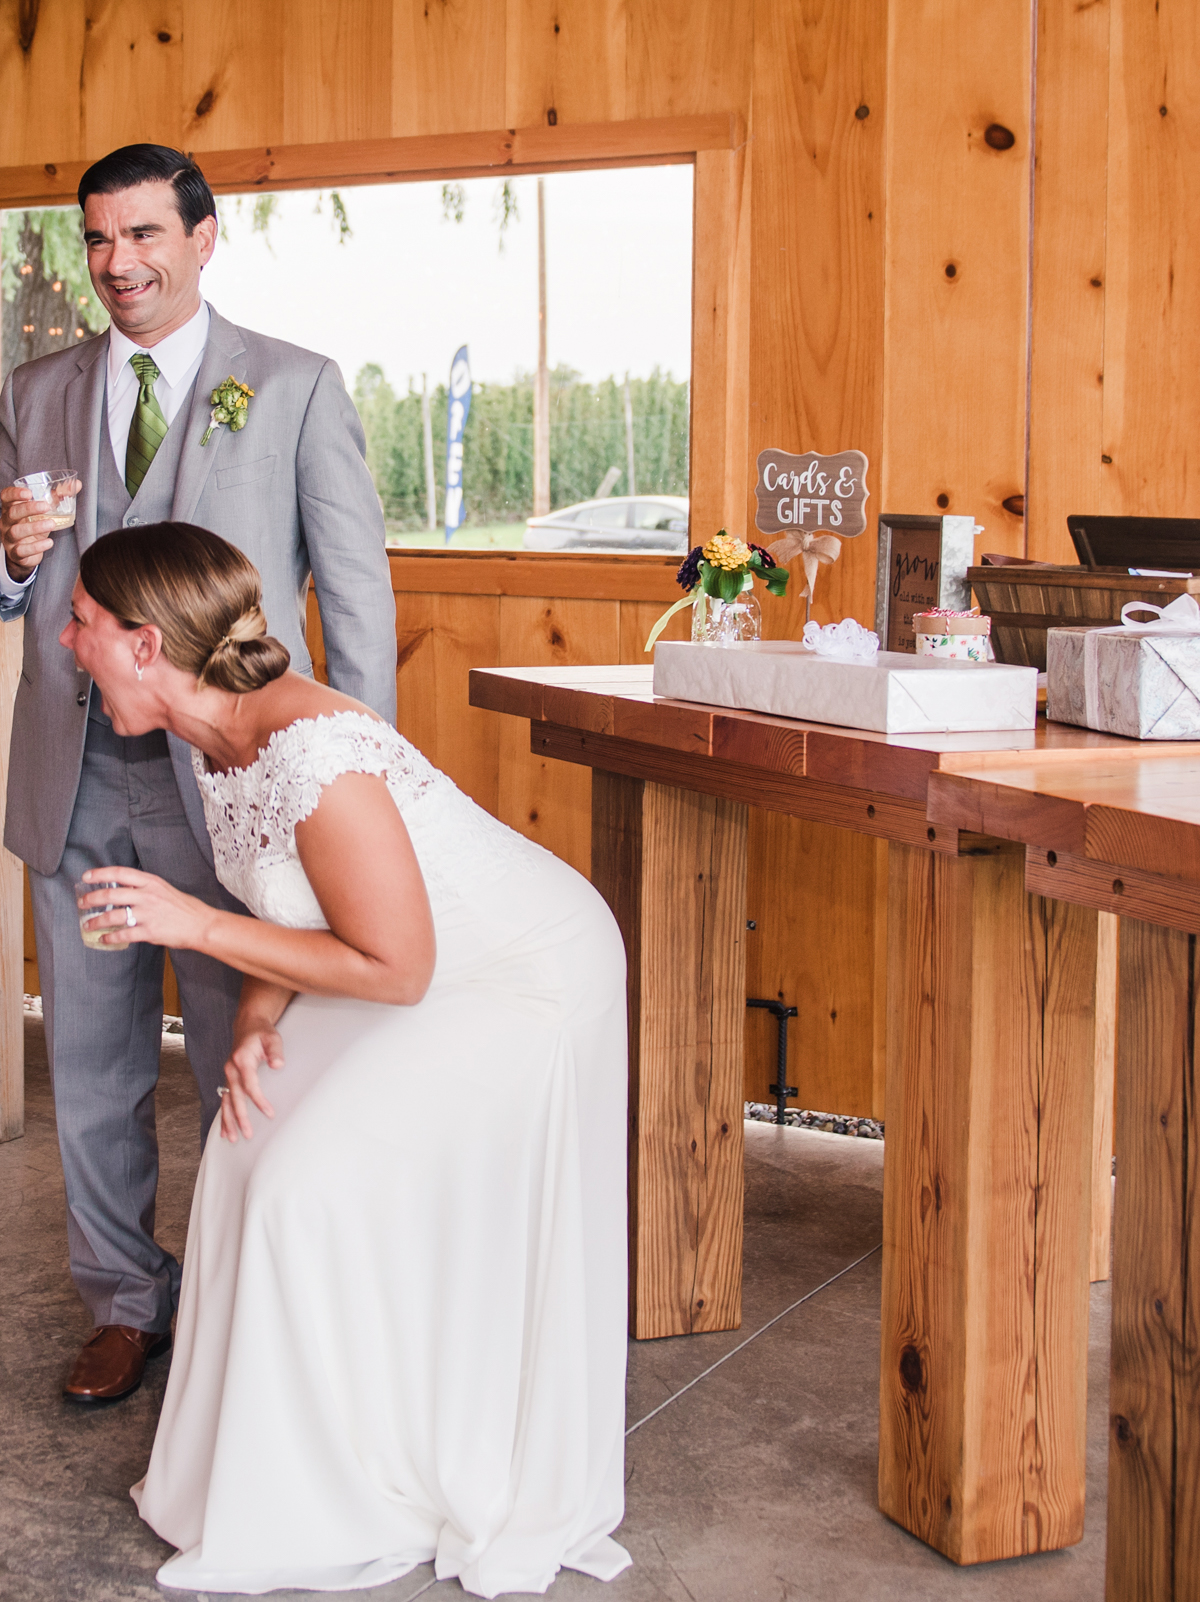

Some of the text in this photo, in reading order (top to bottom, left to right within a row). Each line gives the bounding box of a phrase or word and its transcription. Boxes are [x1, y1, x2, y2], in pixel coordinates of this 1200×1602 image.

[763, 460, 857, 498] Cards &
[777, 497, 842, 526] GIFTS
[893, 552, 939, 597] grow
